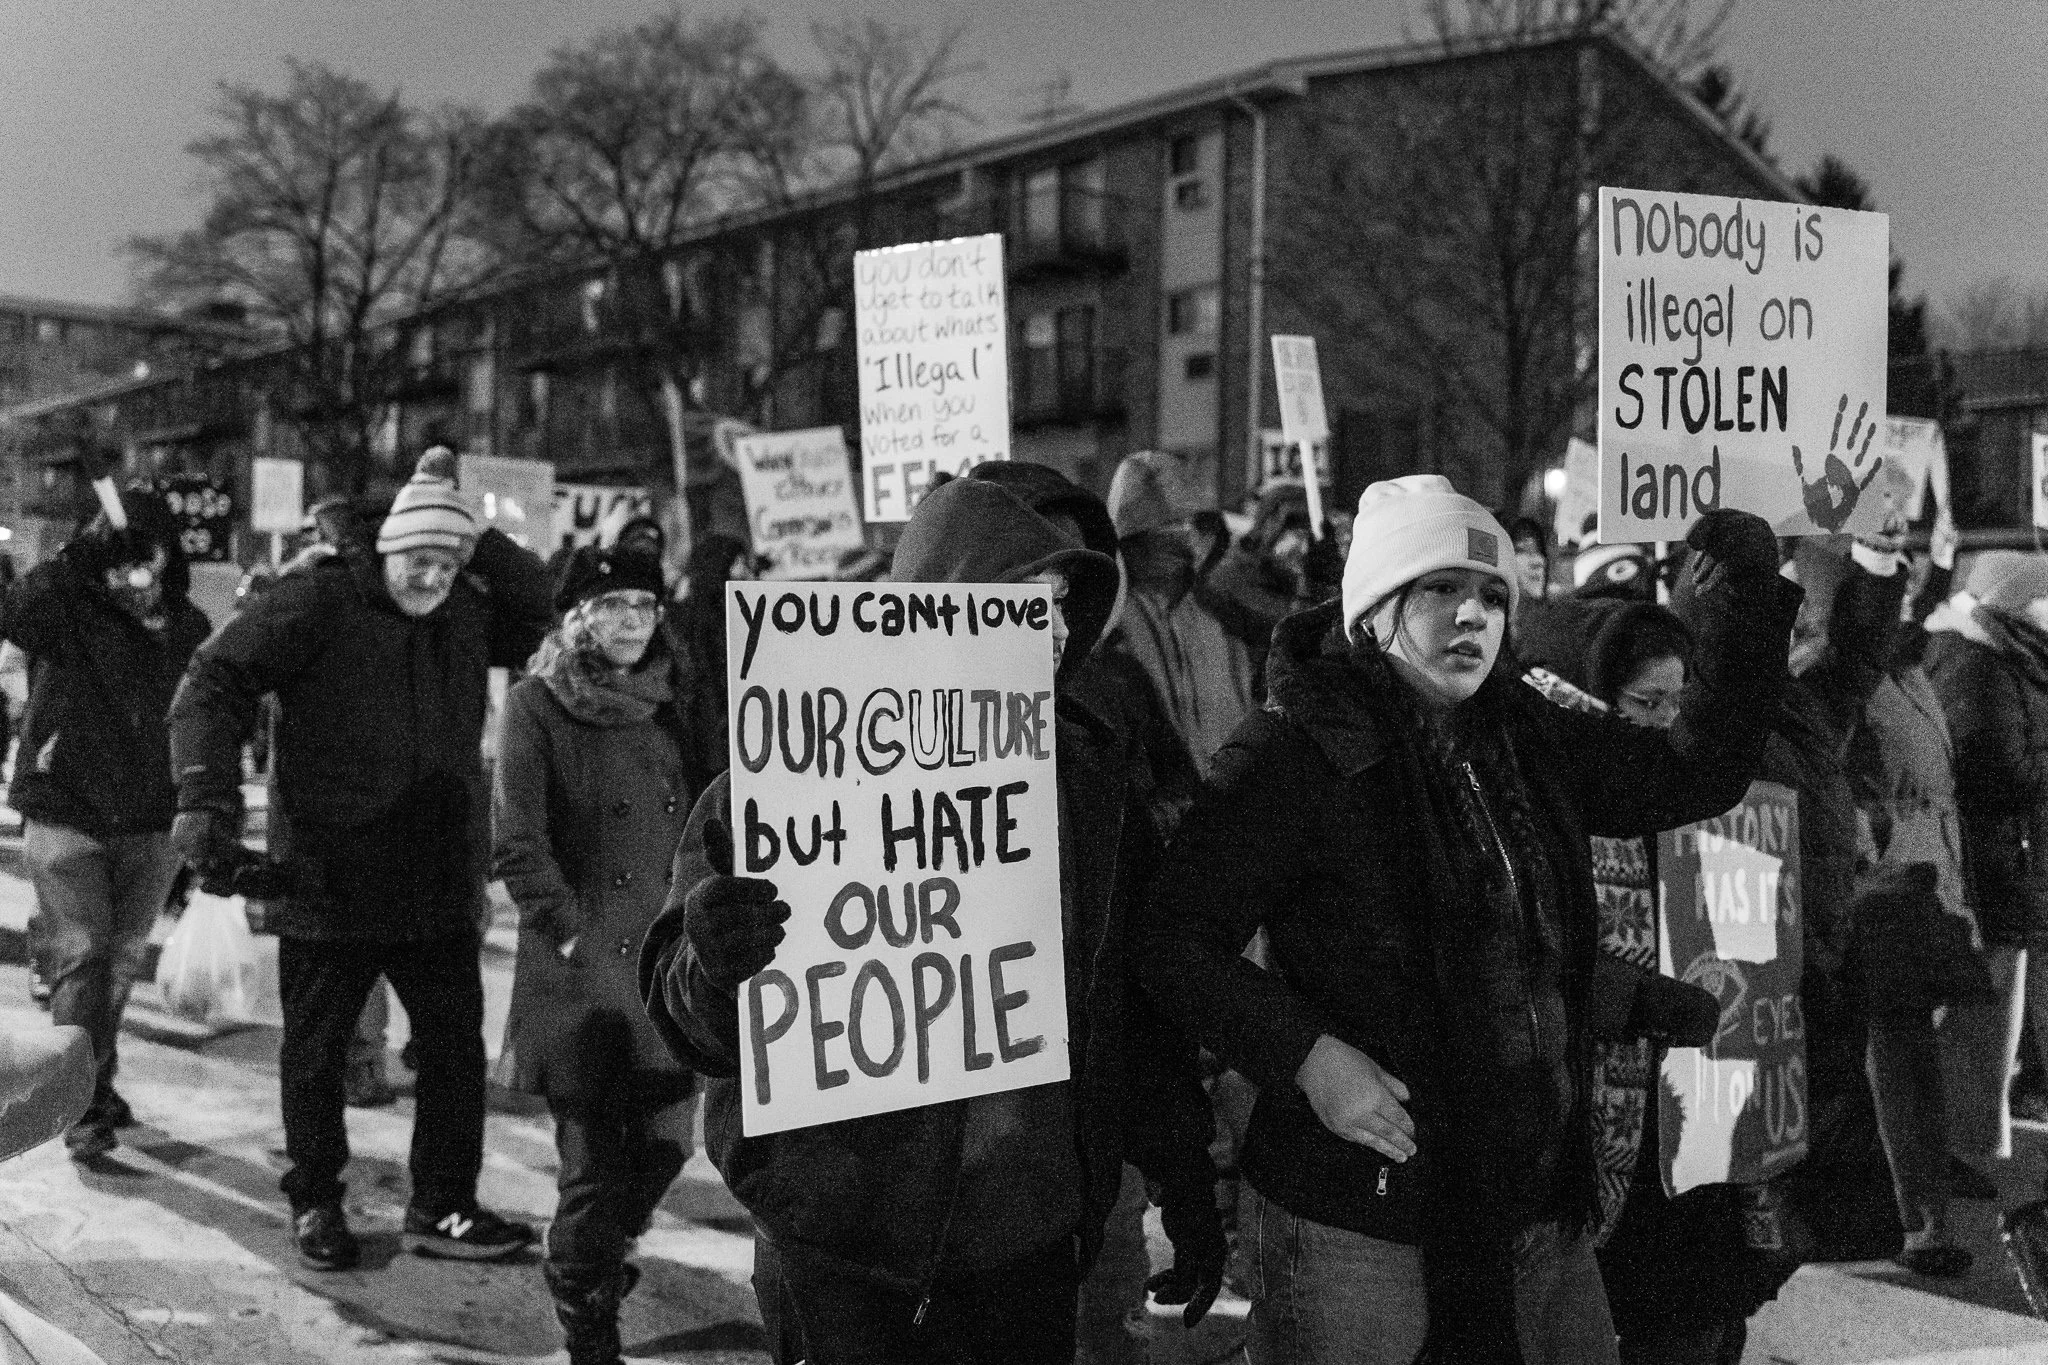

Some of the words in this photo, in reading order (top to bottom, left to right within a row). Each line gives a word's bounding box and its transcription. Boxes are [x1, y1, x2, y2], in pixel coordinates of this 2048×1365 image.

[1612, 196, 1766, 275] nobody
[1794, 206, 1824, 262] is
[860, 255, 912, 311] you
[920, 286, 942, 309] to
[862, 317, 928, 344] about
[1626, 276, 1735, 367] illegal
[1760, 296, 1813, 341] on
[931, 423, 960, 447] for
[970, 424, 989, 444] a
[932, 393, 976, 423] you
[1615, 363, 1789, 435] STOLEN
[1620, 445, 1722, 521] land
[735, 589, 842, 681] you
[967, 592, 1050, 636] love
[737, 684, 848, 778] OUR
[855, 686, 1052, 776] CULTURE
[744, 797, 847, 874] but
[880, 780, 1032, 874] HATE
[824, 876, 962, 950] OUR
[747, 940, 1046, 1106] PEOPLE
[437, 1211, 474, 1239] N
